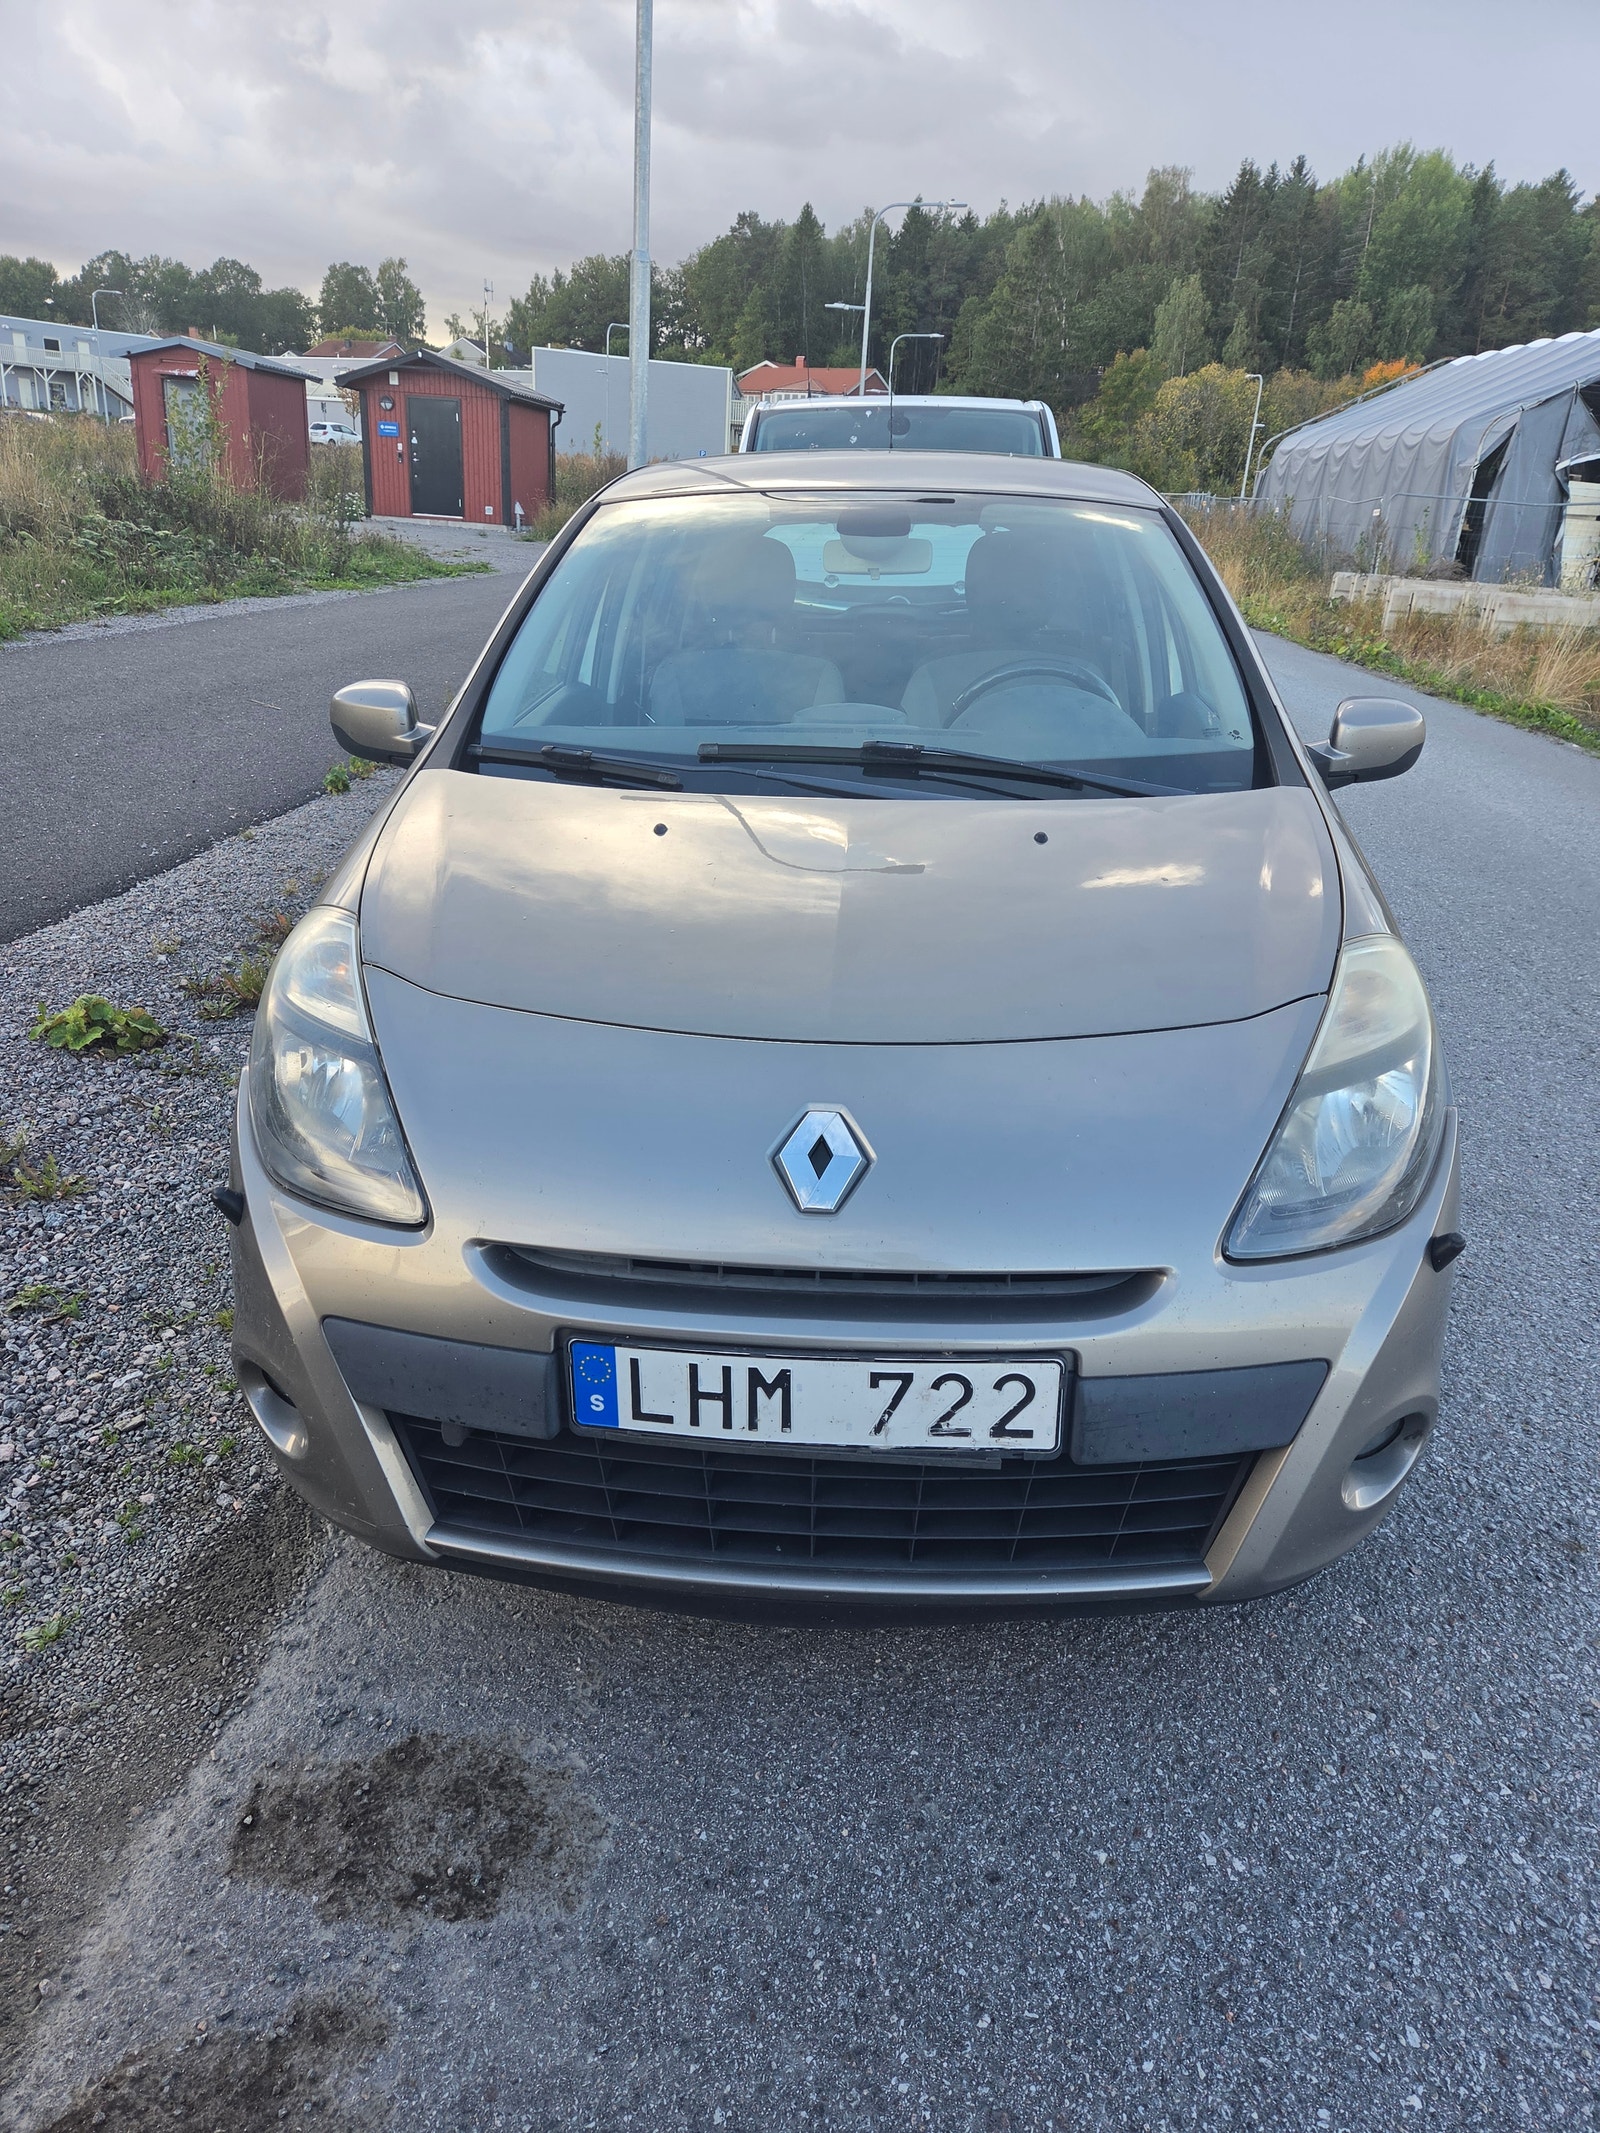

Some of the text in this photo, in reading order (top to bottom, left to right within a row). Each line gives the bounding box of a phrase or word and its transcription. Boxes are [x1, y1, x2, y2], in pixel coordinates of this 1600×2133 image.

[590, 1357, 1036, 1439] S LHM 722
